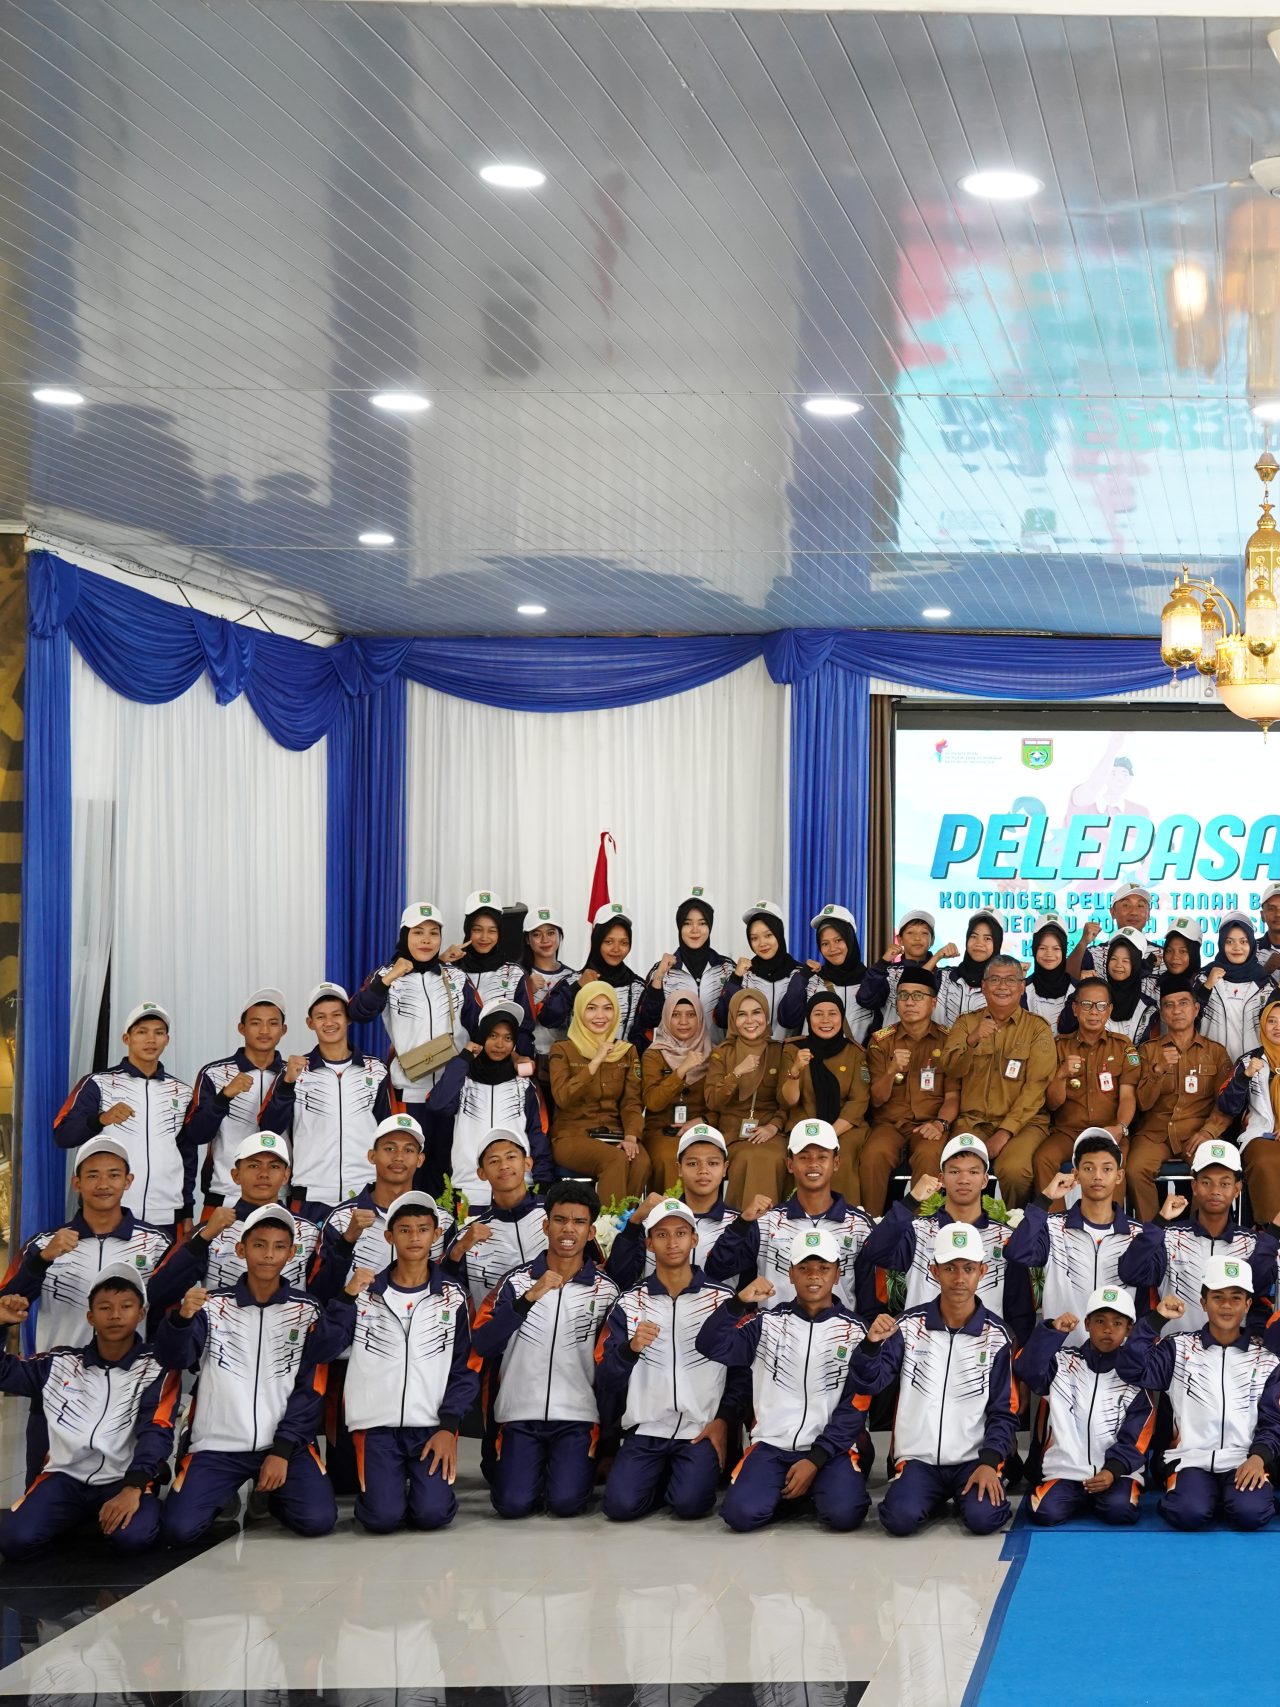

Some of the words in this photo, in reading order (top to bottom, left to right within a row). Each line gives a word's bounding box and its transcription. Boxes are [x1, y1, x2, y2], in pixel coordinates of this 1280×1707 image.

[939, 891, 1057, 909] KONTINGEN
[1067, 892, 1160, 910] PELAR
[1170, 893, 1239, 910] TANAH
